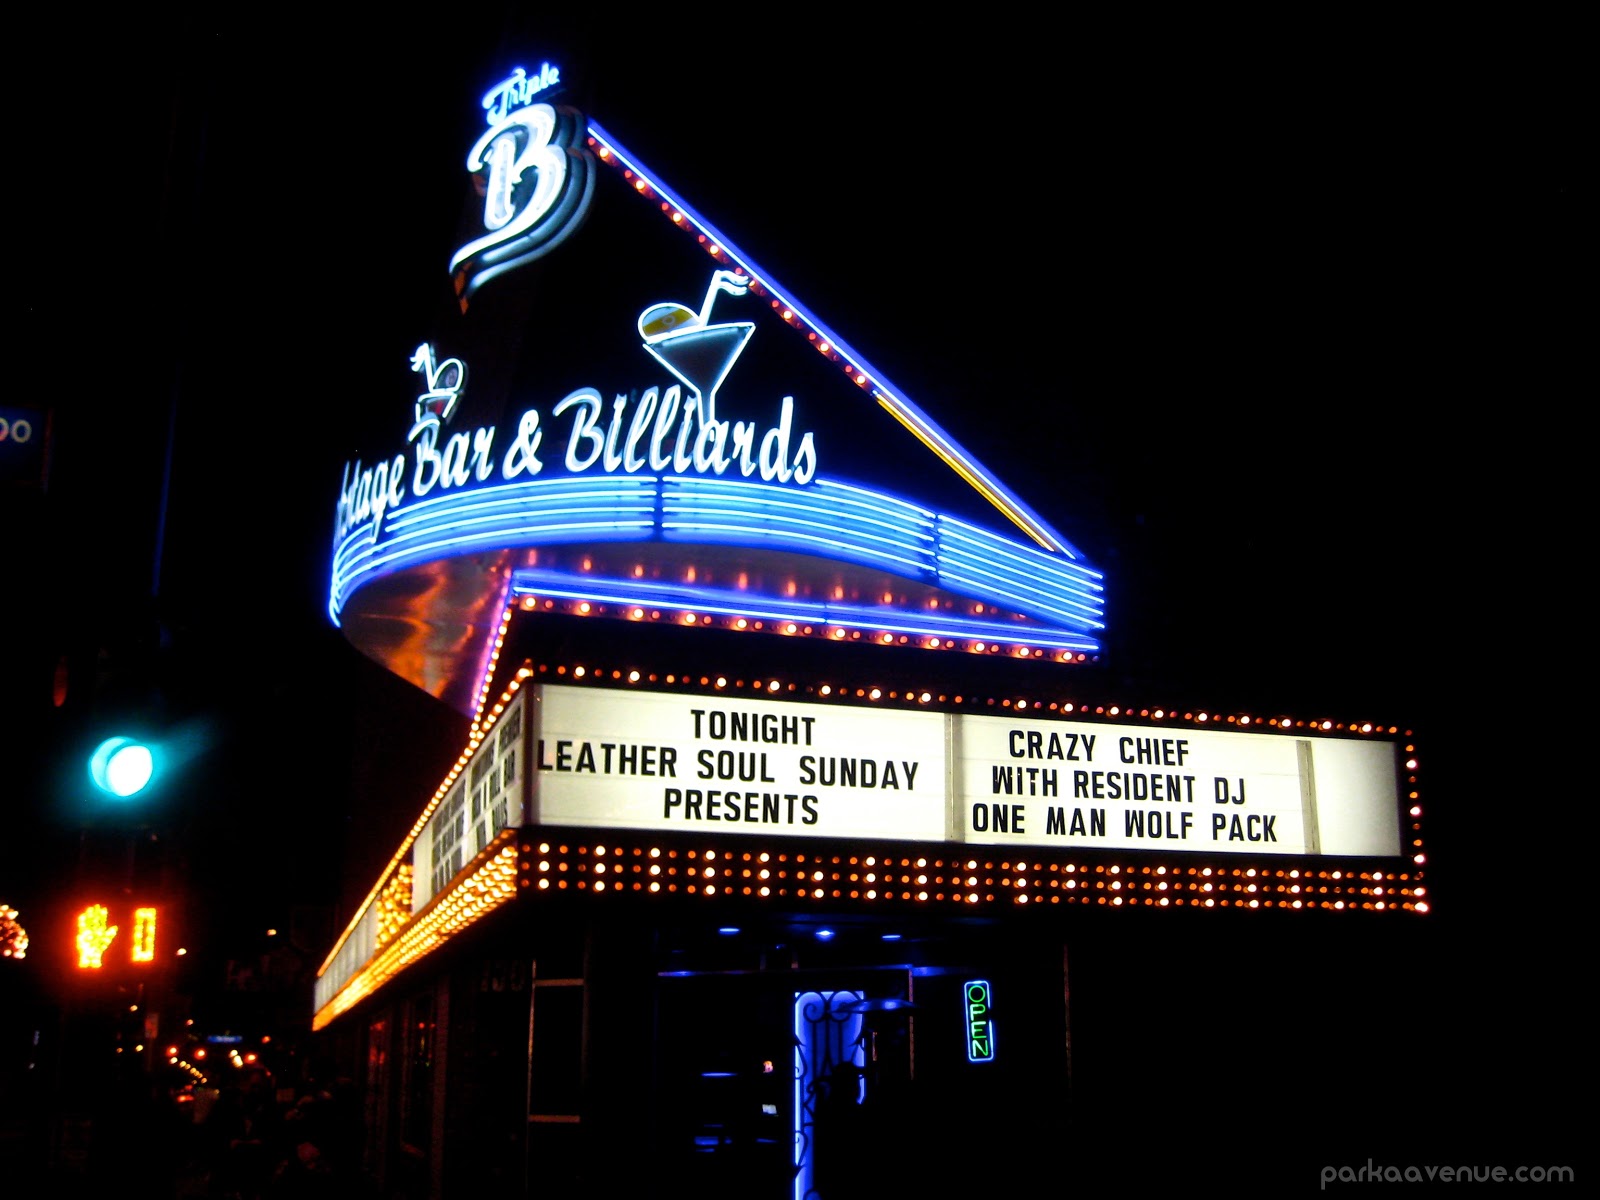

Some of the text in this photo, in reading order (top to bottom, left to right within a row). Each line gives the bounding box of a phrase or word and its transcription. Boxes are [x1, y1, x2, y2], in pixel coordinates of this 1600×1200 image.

[481, 61, 561, 126] Triple
[449, 103, 570, 277] B
[407, 412, 496, 497] Bar
[502, 409, 545, 480] &
[552, 384, 817, 485] Billiards
[690, 709, 816, 746] TONIGHT
[1009, 729, 1190, 767] CRAZY CHIEF
[537, 739, 678, 778] LEATHER
[697, 749, 776, 784] SOUL
[799, 755, 919, 791] SUNDAY
[992, 765, 1246, 806] WITH RESIDENT DJ
[663, 788, 819, 826] PRESENTS
[972, 803, 1278, 843] ONE MAN WOLF PACK
[968, 985, 989, 1057] OPEN
